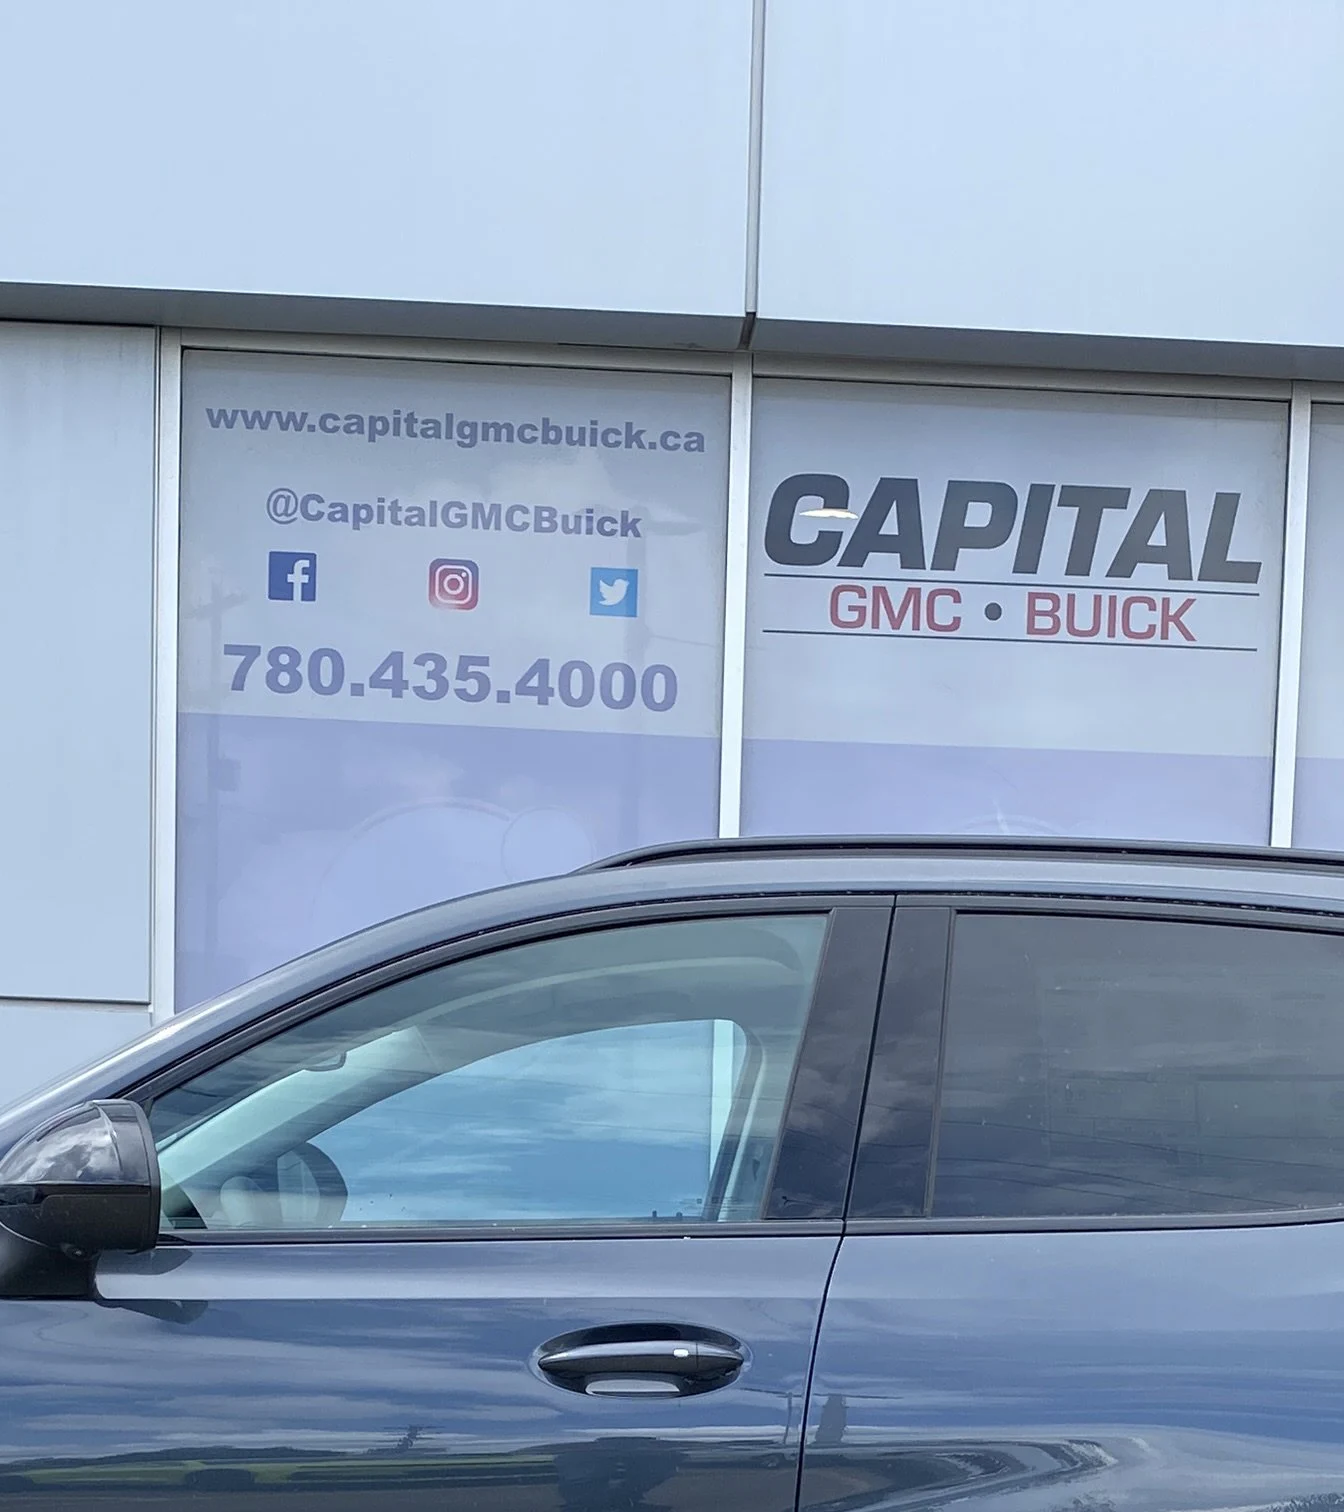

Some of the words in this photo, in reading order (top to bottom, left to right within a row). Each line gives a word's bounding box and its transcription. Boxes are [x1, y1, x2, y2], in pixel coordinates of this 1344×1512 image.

[205, 407, 706, 453] www.capitalgmcbuick.ca
[266, 487, 642, 539] @CapitalGMCBuick
[763, 472, 1263, 584] CAPITAL
[829, 584, 963, 633] GMC
[1024, 591, 1197, 641] BUICK
[223, 643, 678, 712] 780.435.4000
